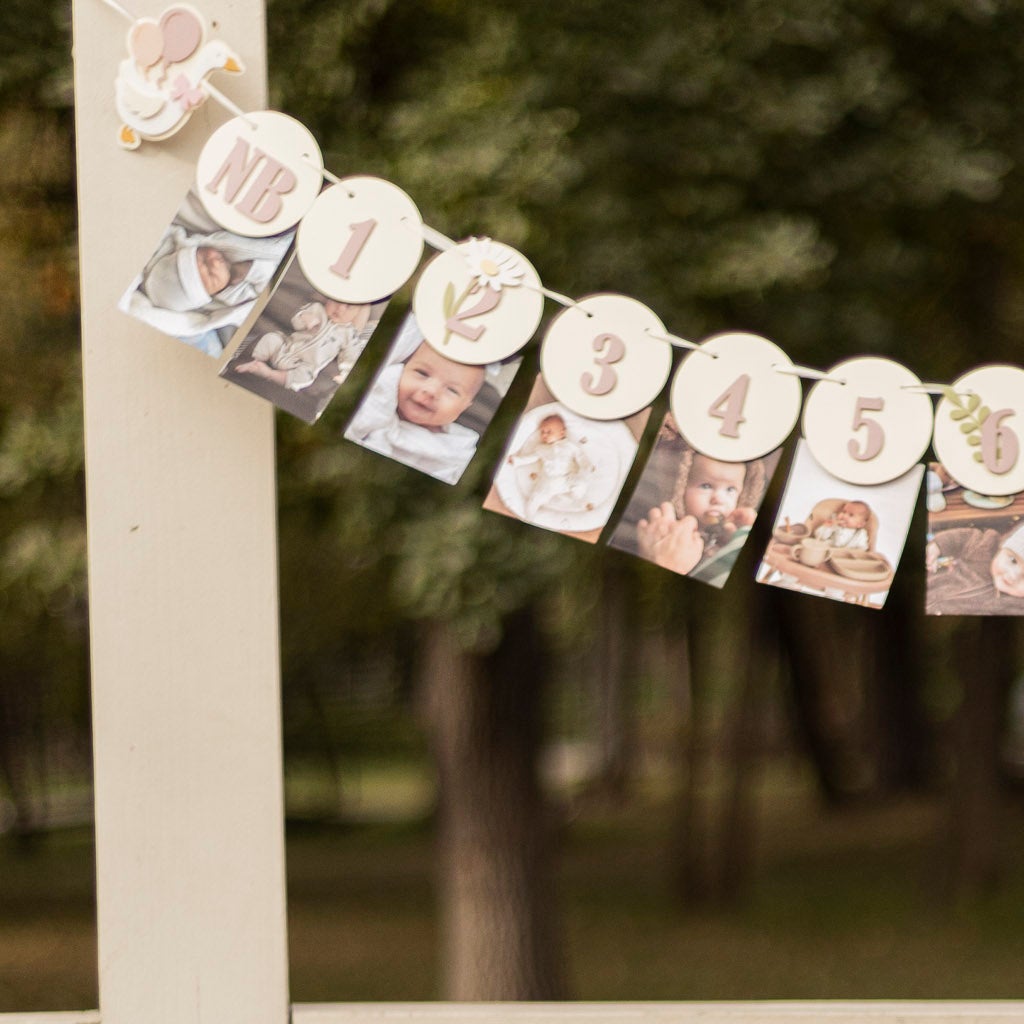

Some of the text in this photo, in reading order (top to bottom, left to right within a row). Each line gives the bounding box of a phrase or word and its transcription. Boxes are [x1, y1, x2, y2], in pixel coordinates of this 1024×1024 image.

[206, 138, 296, 223] NB
[330, 218, 377, 279] 1
[446, 284, 503, 341] 2
[581, 334, 625, 396] 3
[709, 374, 752, 438] 4
[847, 397, 885, 461] 5
[981, 408, 1020, 474] 6
